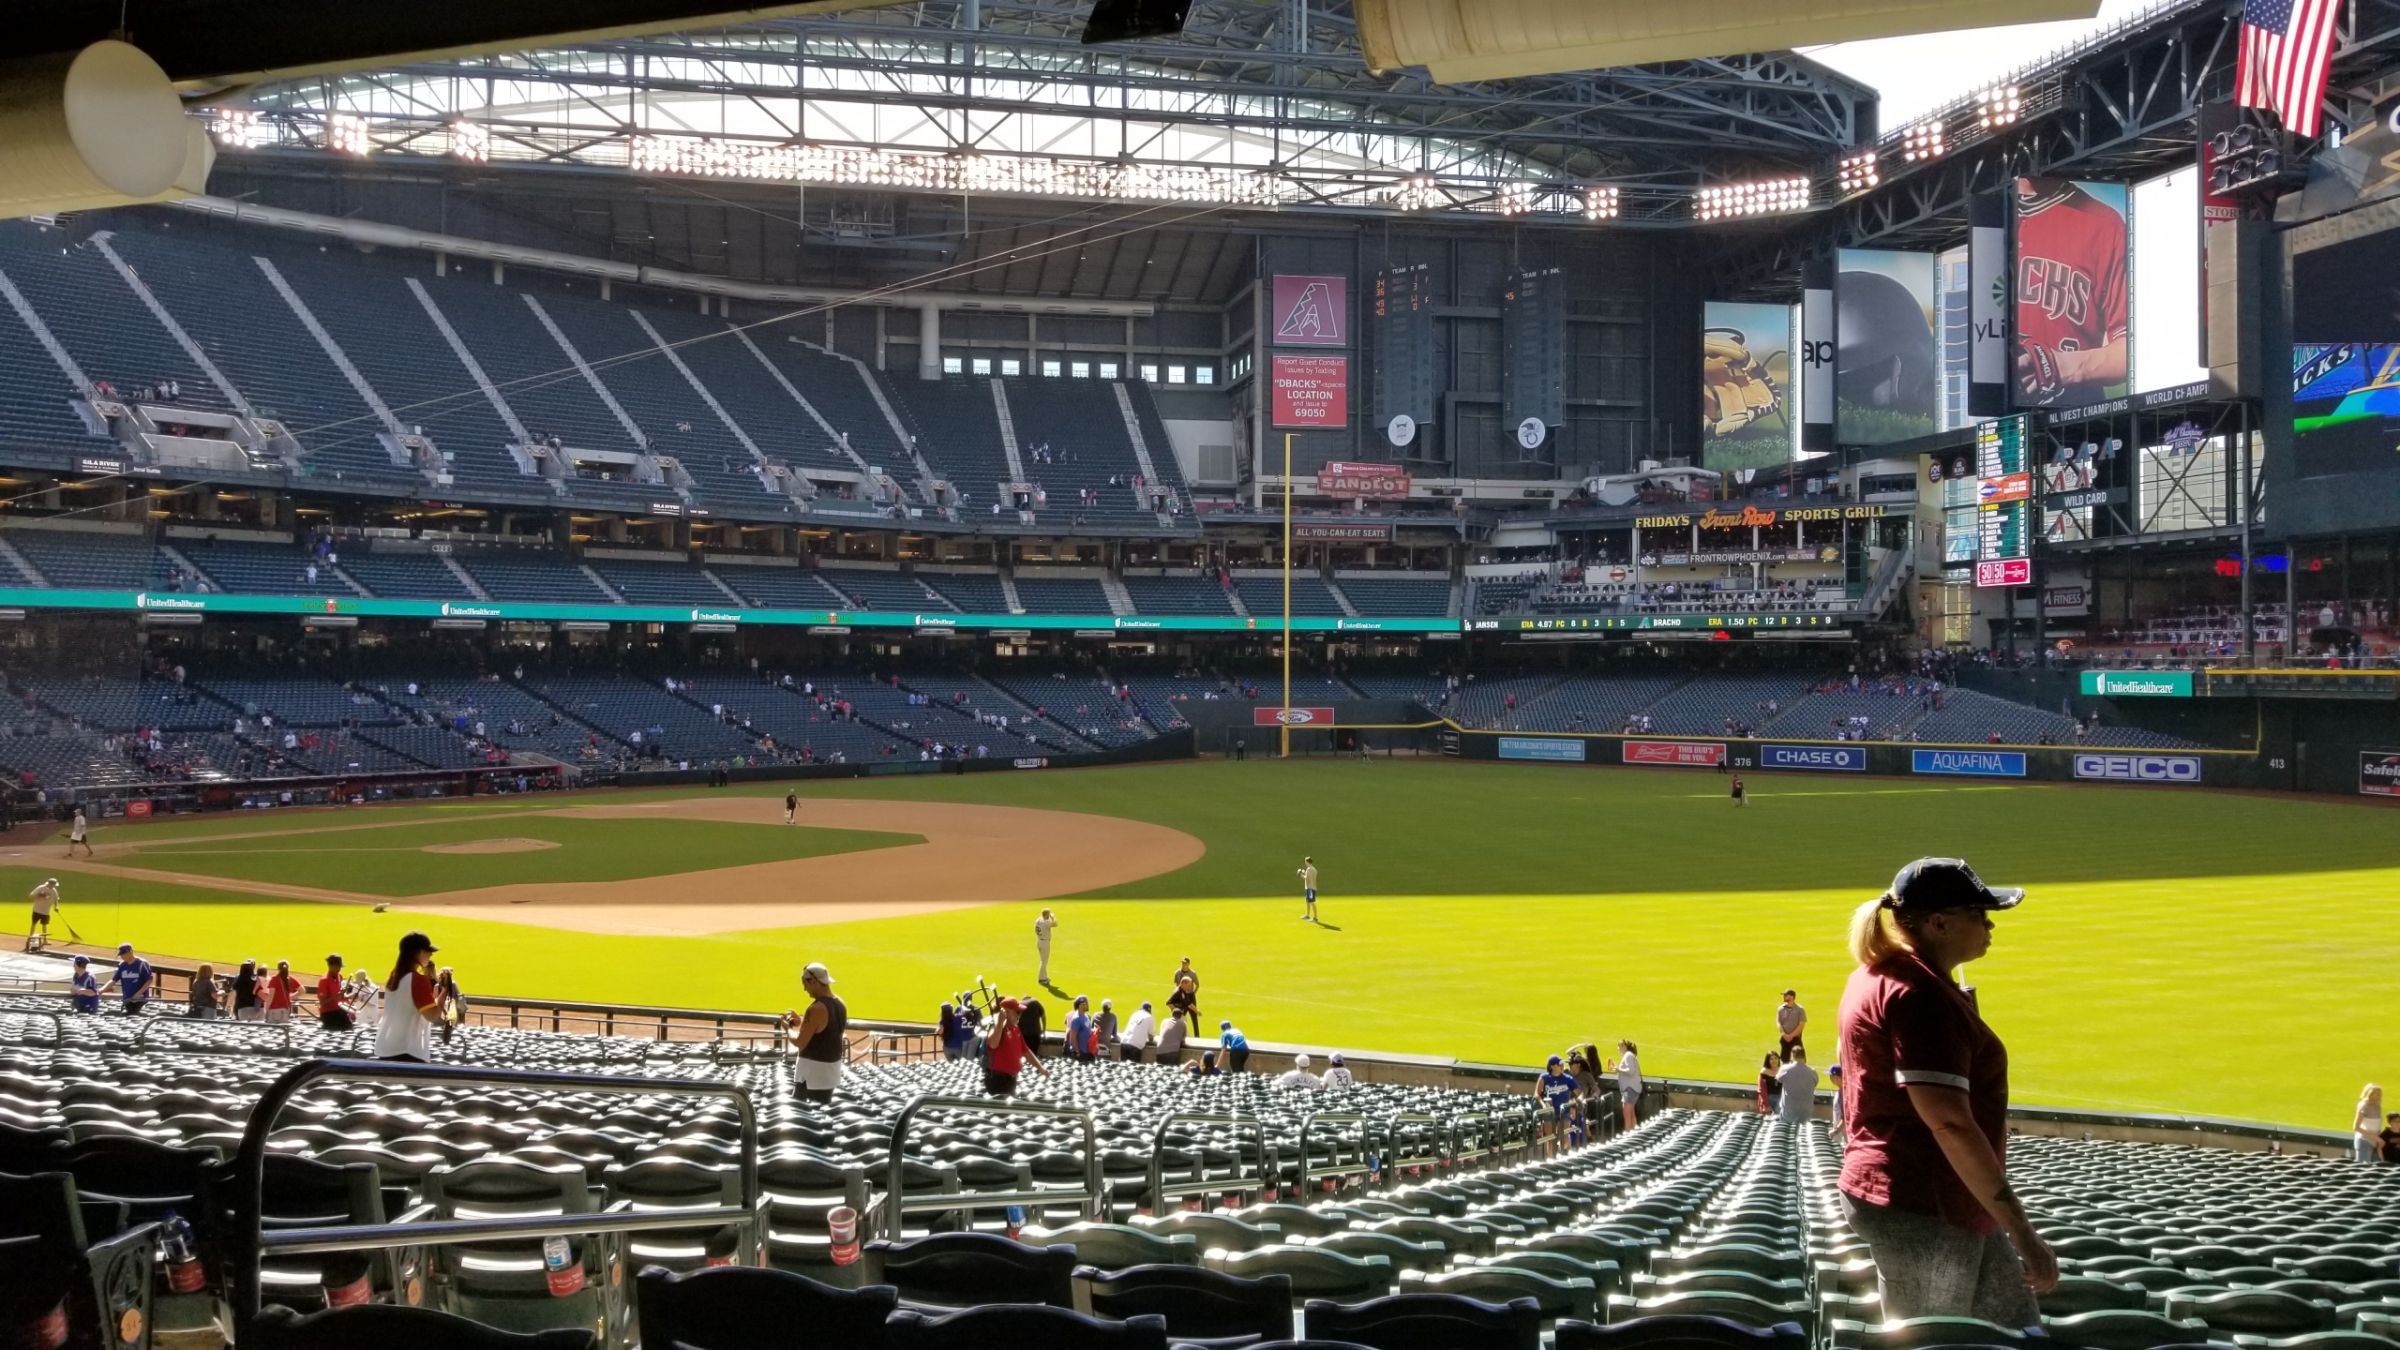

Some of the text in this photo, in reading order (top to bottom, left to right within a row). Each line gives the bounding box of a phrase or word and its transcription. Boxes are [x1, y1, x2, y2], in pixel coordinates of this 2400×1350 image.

[1306, 367, 1313, 375] by
[1287, 390, 1333, 399] LOCATION
[1295, 408, 1325, 417] 69050
[1322, 477, 1407, 490] SANDLOT
[2064, 491, 2107, 507] WILD CARD
[1635, 514, 1690, 528] FRIDAY'S
[1784, 508, 1840, 521] SPORTS
[1845, 506, 1888, 519] GRILL
[1362, 529, 1386, 537] SEATS
[2054, 593, 2081, 605] FITNESS
[1475, 621, 1498, 629] JANSEN
[1556, 620, 1565, 628] PC
[1653, 618, 1681, 626] BRACHO
[1728, 618, 1744, 626] 1.50
[2107, 681, 2173, 693] UnitedHealthcare
[1776, 751, 1832, 764] CHASE
[1932, 753, 2004, 771] AQUAFINA
[2269, 758, 2285, 768] 413
[2077, 756, 2198, 779] GEICO
